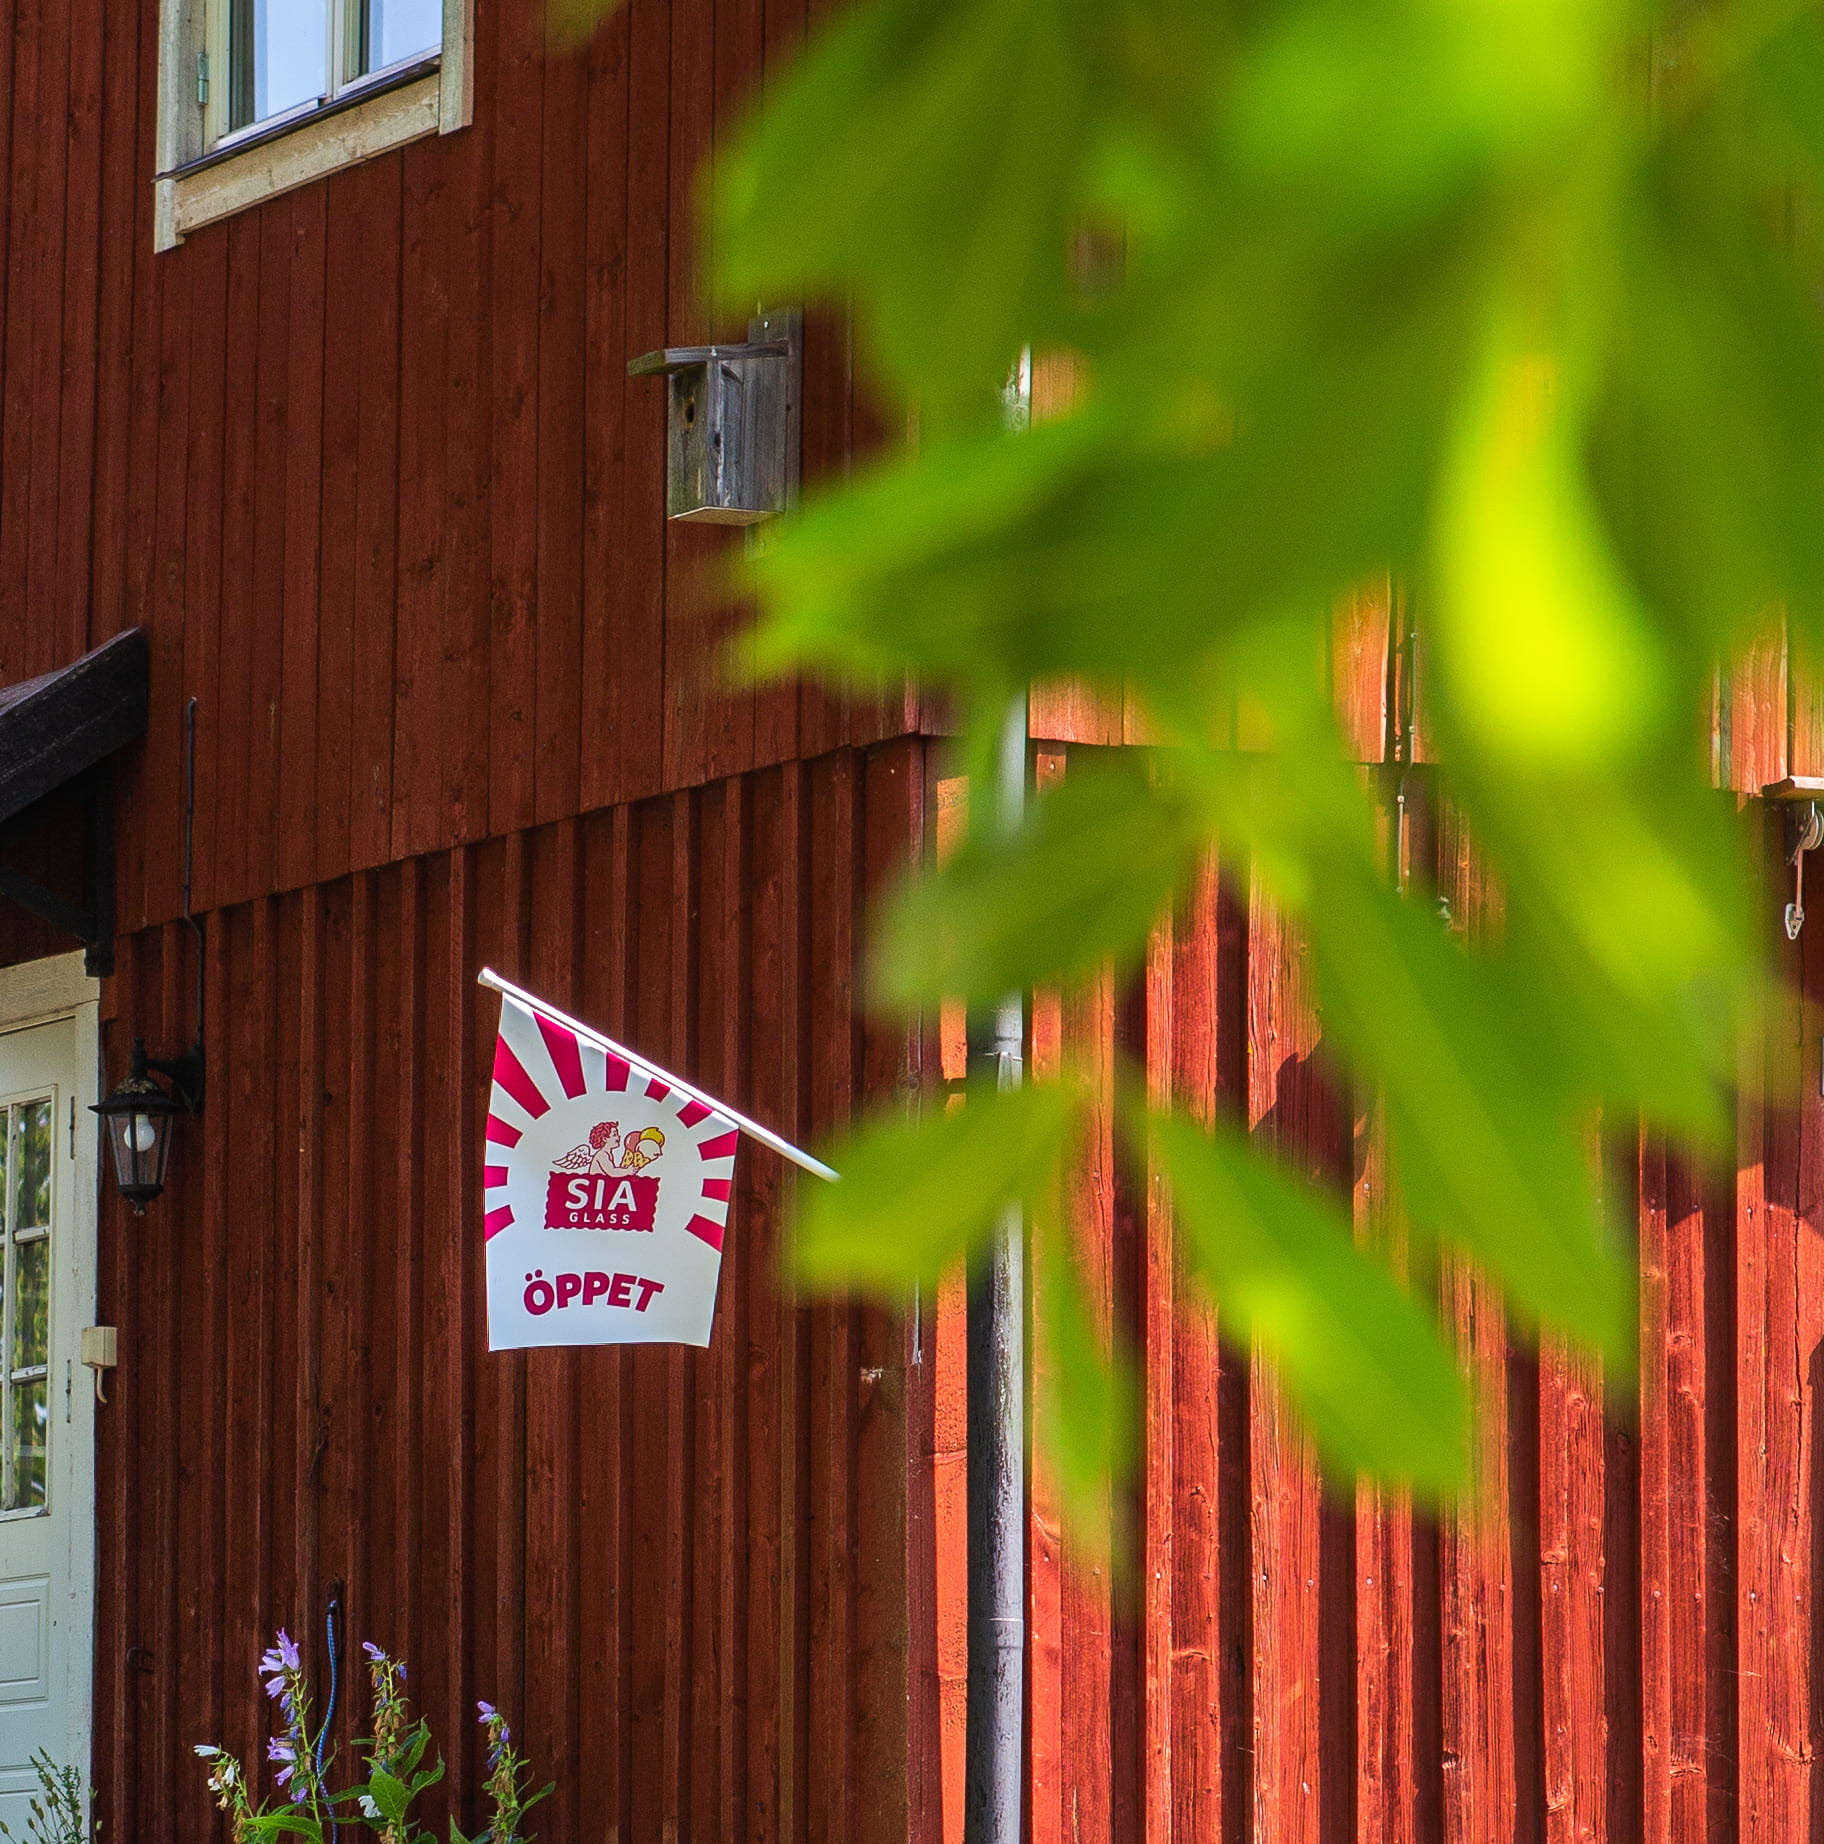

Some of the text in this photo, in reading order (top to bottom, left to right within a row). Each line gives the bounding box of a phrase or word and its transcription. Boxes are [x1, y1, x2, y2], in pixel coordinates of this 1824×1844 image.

[565, 1178, 638, 1212] SIA
[569, 1212, 631, 1225] GLASS
[523, 1269, 665, 1315] ÖPPET
